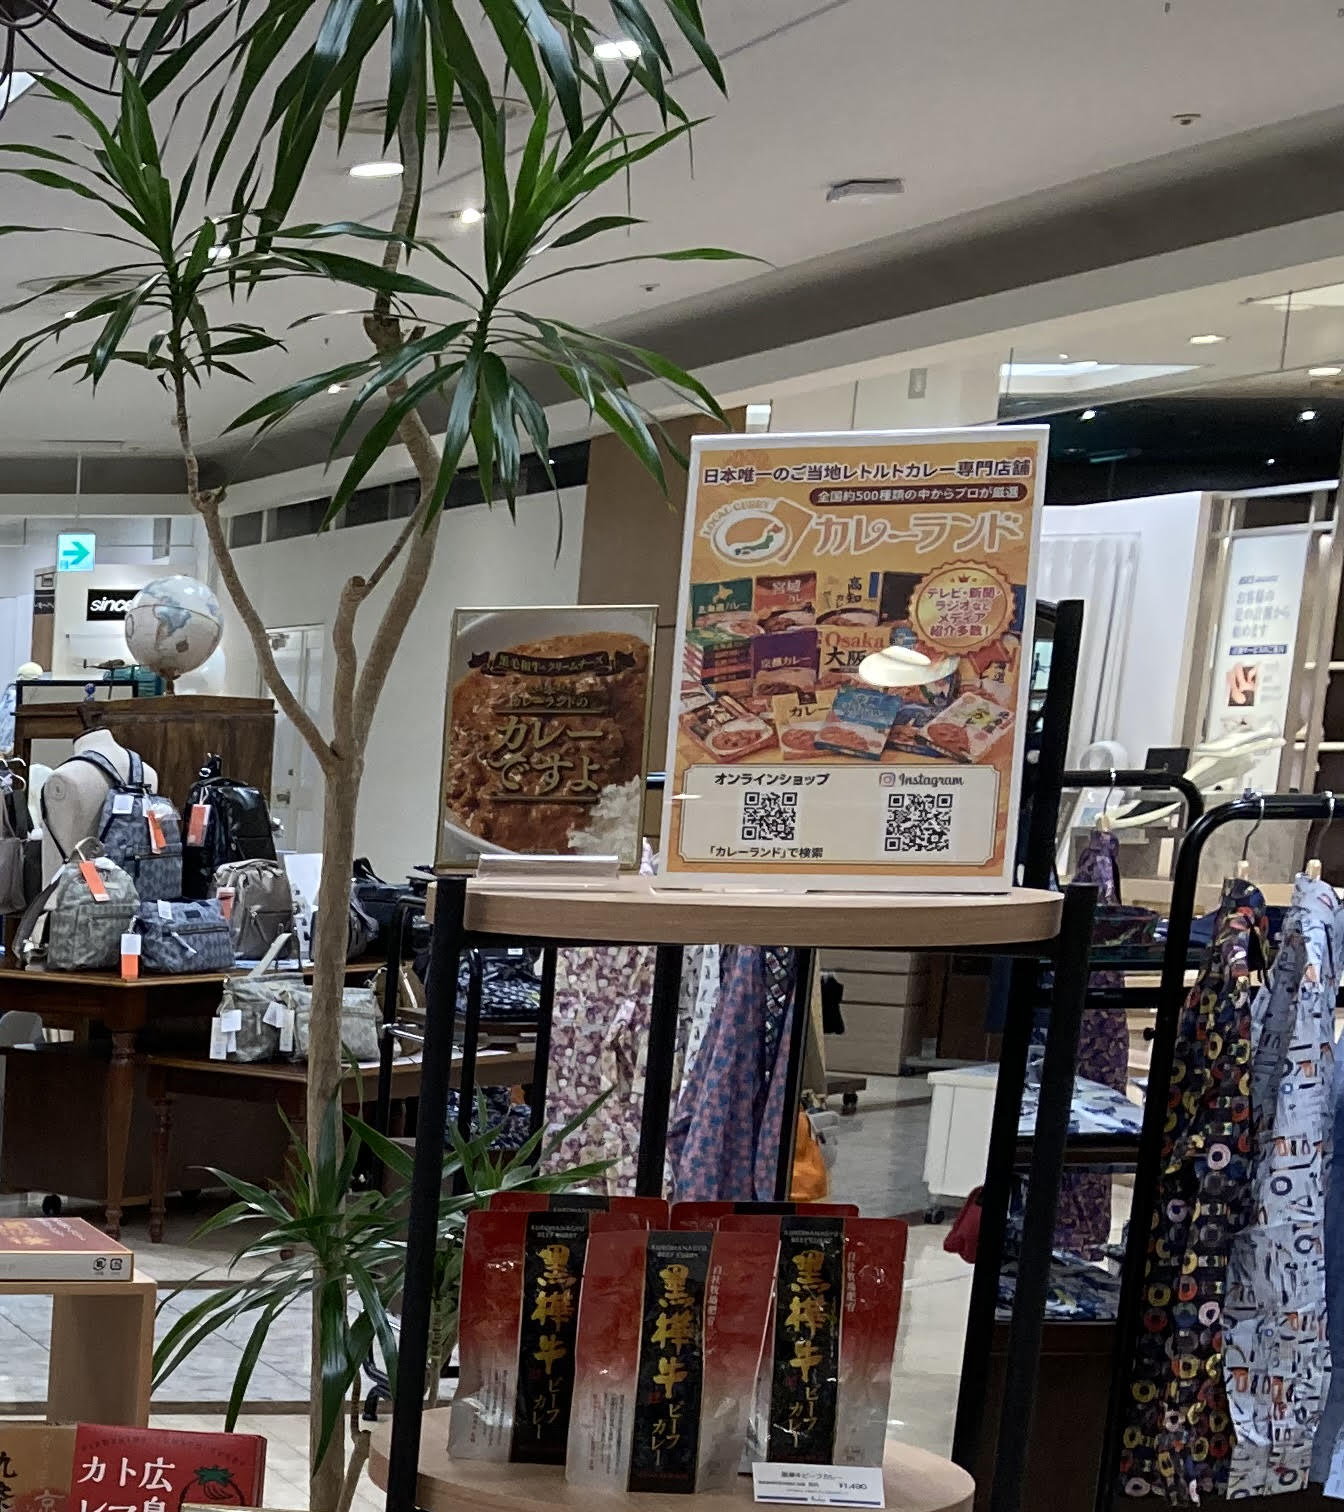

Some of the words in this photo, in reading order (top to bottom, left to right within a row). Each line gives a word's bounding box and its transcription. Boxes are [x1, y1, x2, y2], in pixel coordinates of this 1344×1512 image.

[704, 459, 1030, 485] 日本唯一のご当地レトルトカレー専門店舗
[814, 511, 1025, 555] カレーランド
[936, 600, 990, 611] ラジオなど
[940, 613, 985, 623] メディア
[825, 632, 884, 648] Osaka
[789, 706, 830, 717] カレー
[492, 715, 604, 752] カレー
[714, 772, 830, 787] オンラインショップ
[899, 773, 964, 787] Instagram
[666, 1401, 685, 1450] ビーフ
[651, 1419, 669, 1466] カレー
